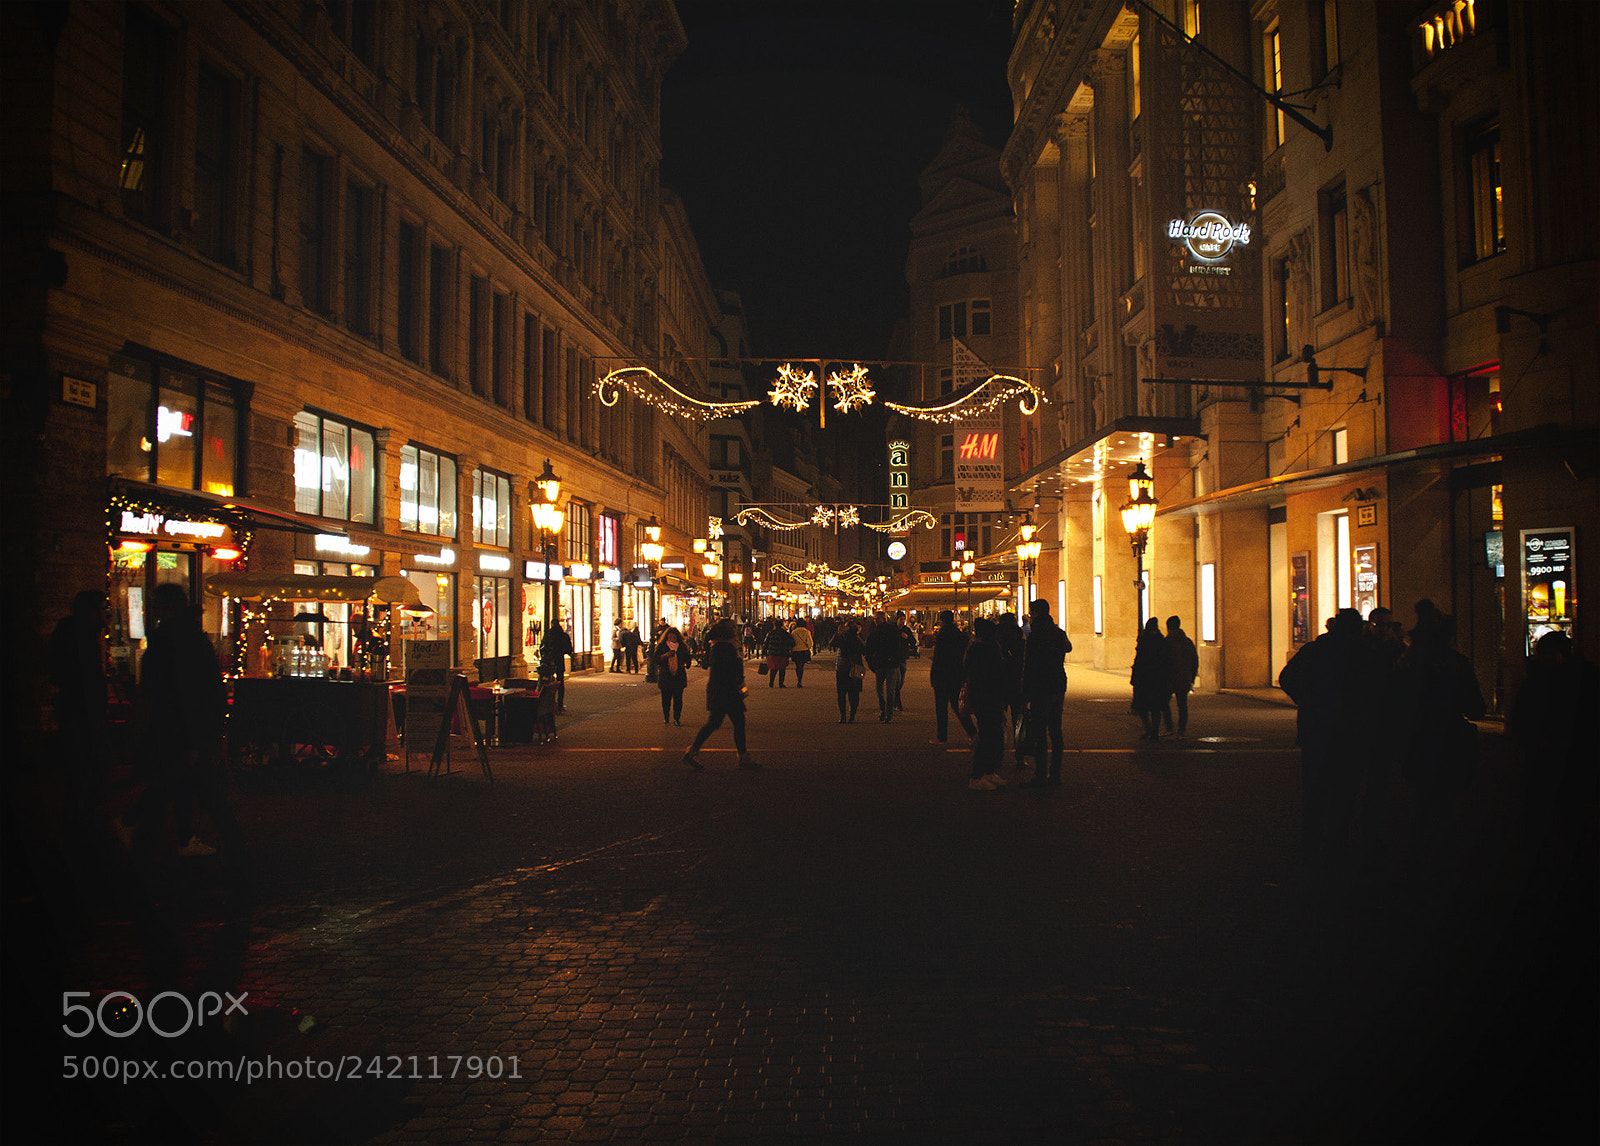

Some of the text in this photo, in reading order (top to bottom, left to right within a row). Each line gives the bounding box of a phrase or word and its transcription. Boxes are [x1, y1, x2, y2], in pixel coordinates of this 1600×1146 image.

[1169, 219, 1250, 244] Hard Rock
[1189, 265, 1231, 276] BUDAPEST
[959, 433, 999, 460] H&M
[1530, 565, 1553, 576] 9900
